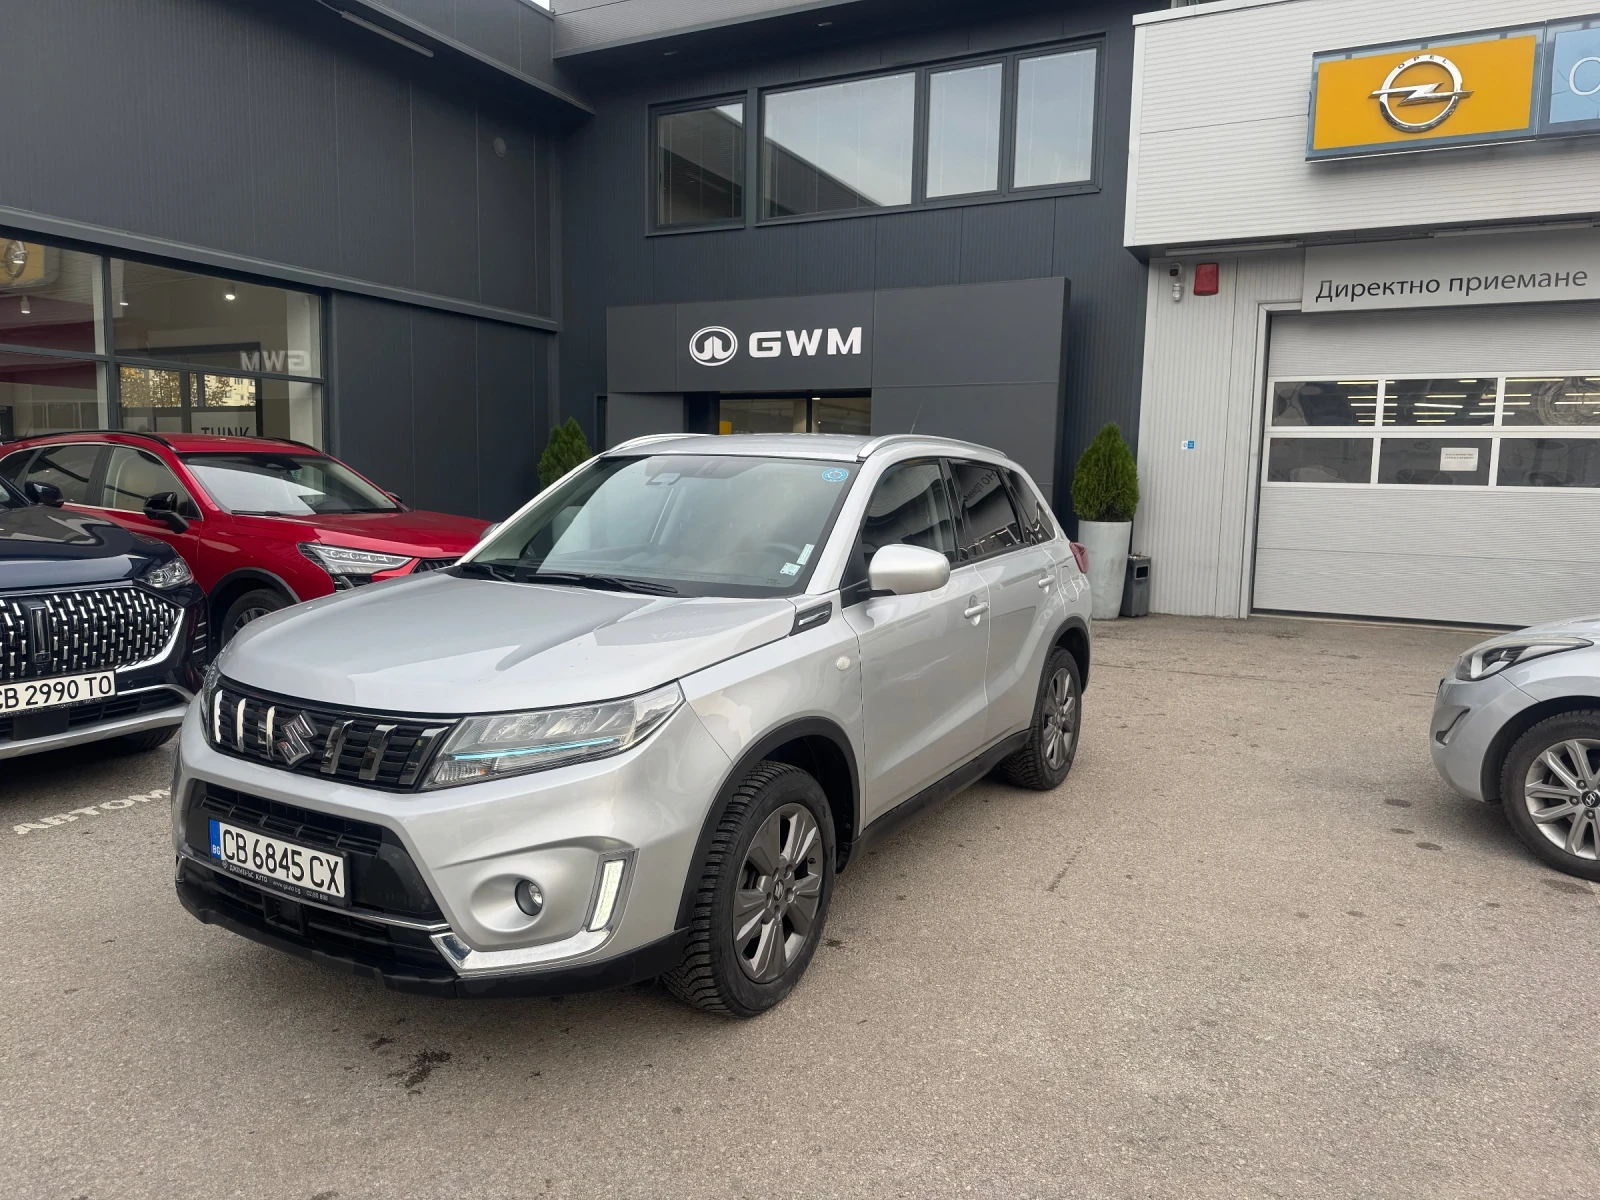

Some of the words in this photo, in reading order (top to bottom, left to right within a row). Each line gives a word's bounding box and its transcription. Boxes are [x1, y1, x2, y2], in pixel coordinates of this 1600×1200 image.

[1397, 54, 1447, 69] OPEL
[1315, 278, 1441, 303] Директно
[1448, 270, 1588, 296] приемане
[748, 326, 862, 358] GWM
[0, 687, 19, 709] B
[25, 680, 79, 706] 2990
[84, 676, 112, 697] TO
[212, 844, 221, 855] BG
[223, 829, 248, 864] CB
[252, 838, 305, 881] 6845
[309, 855, 341, 894] CX
